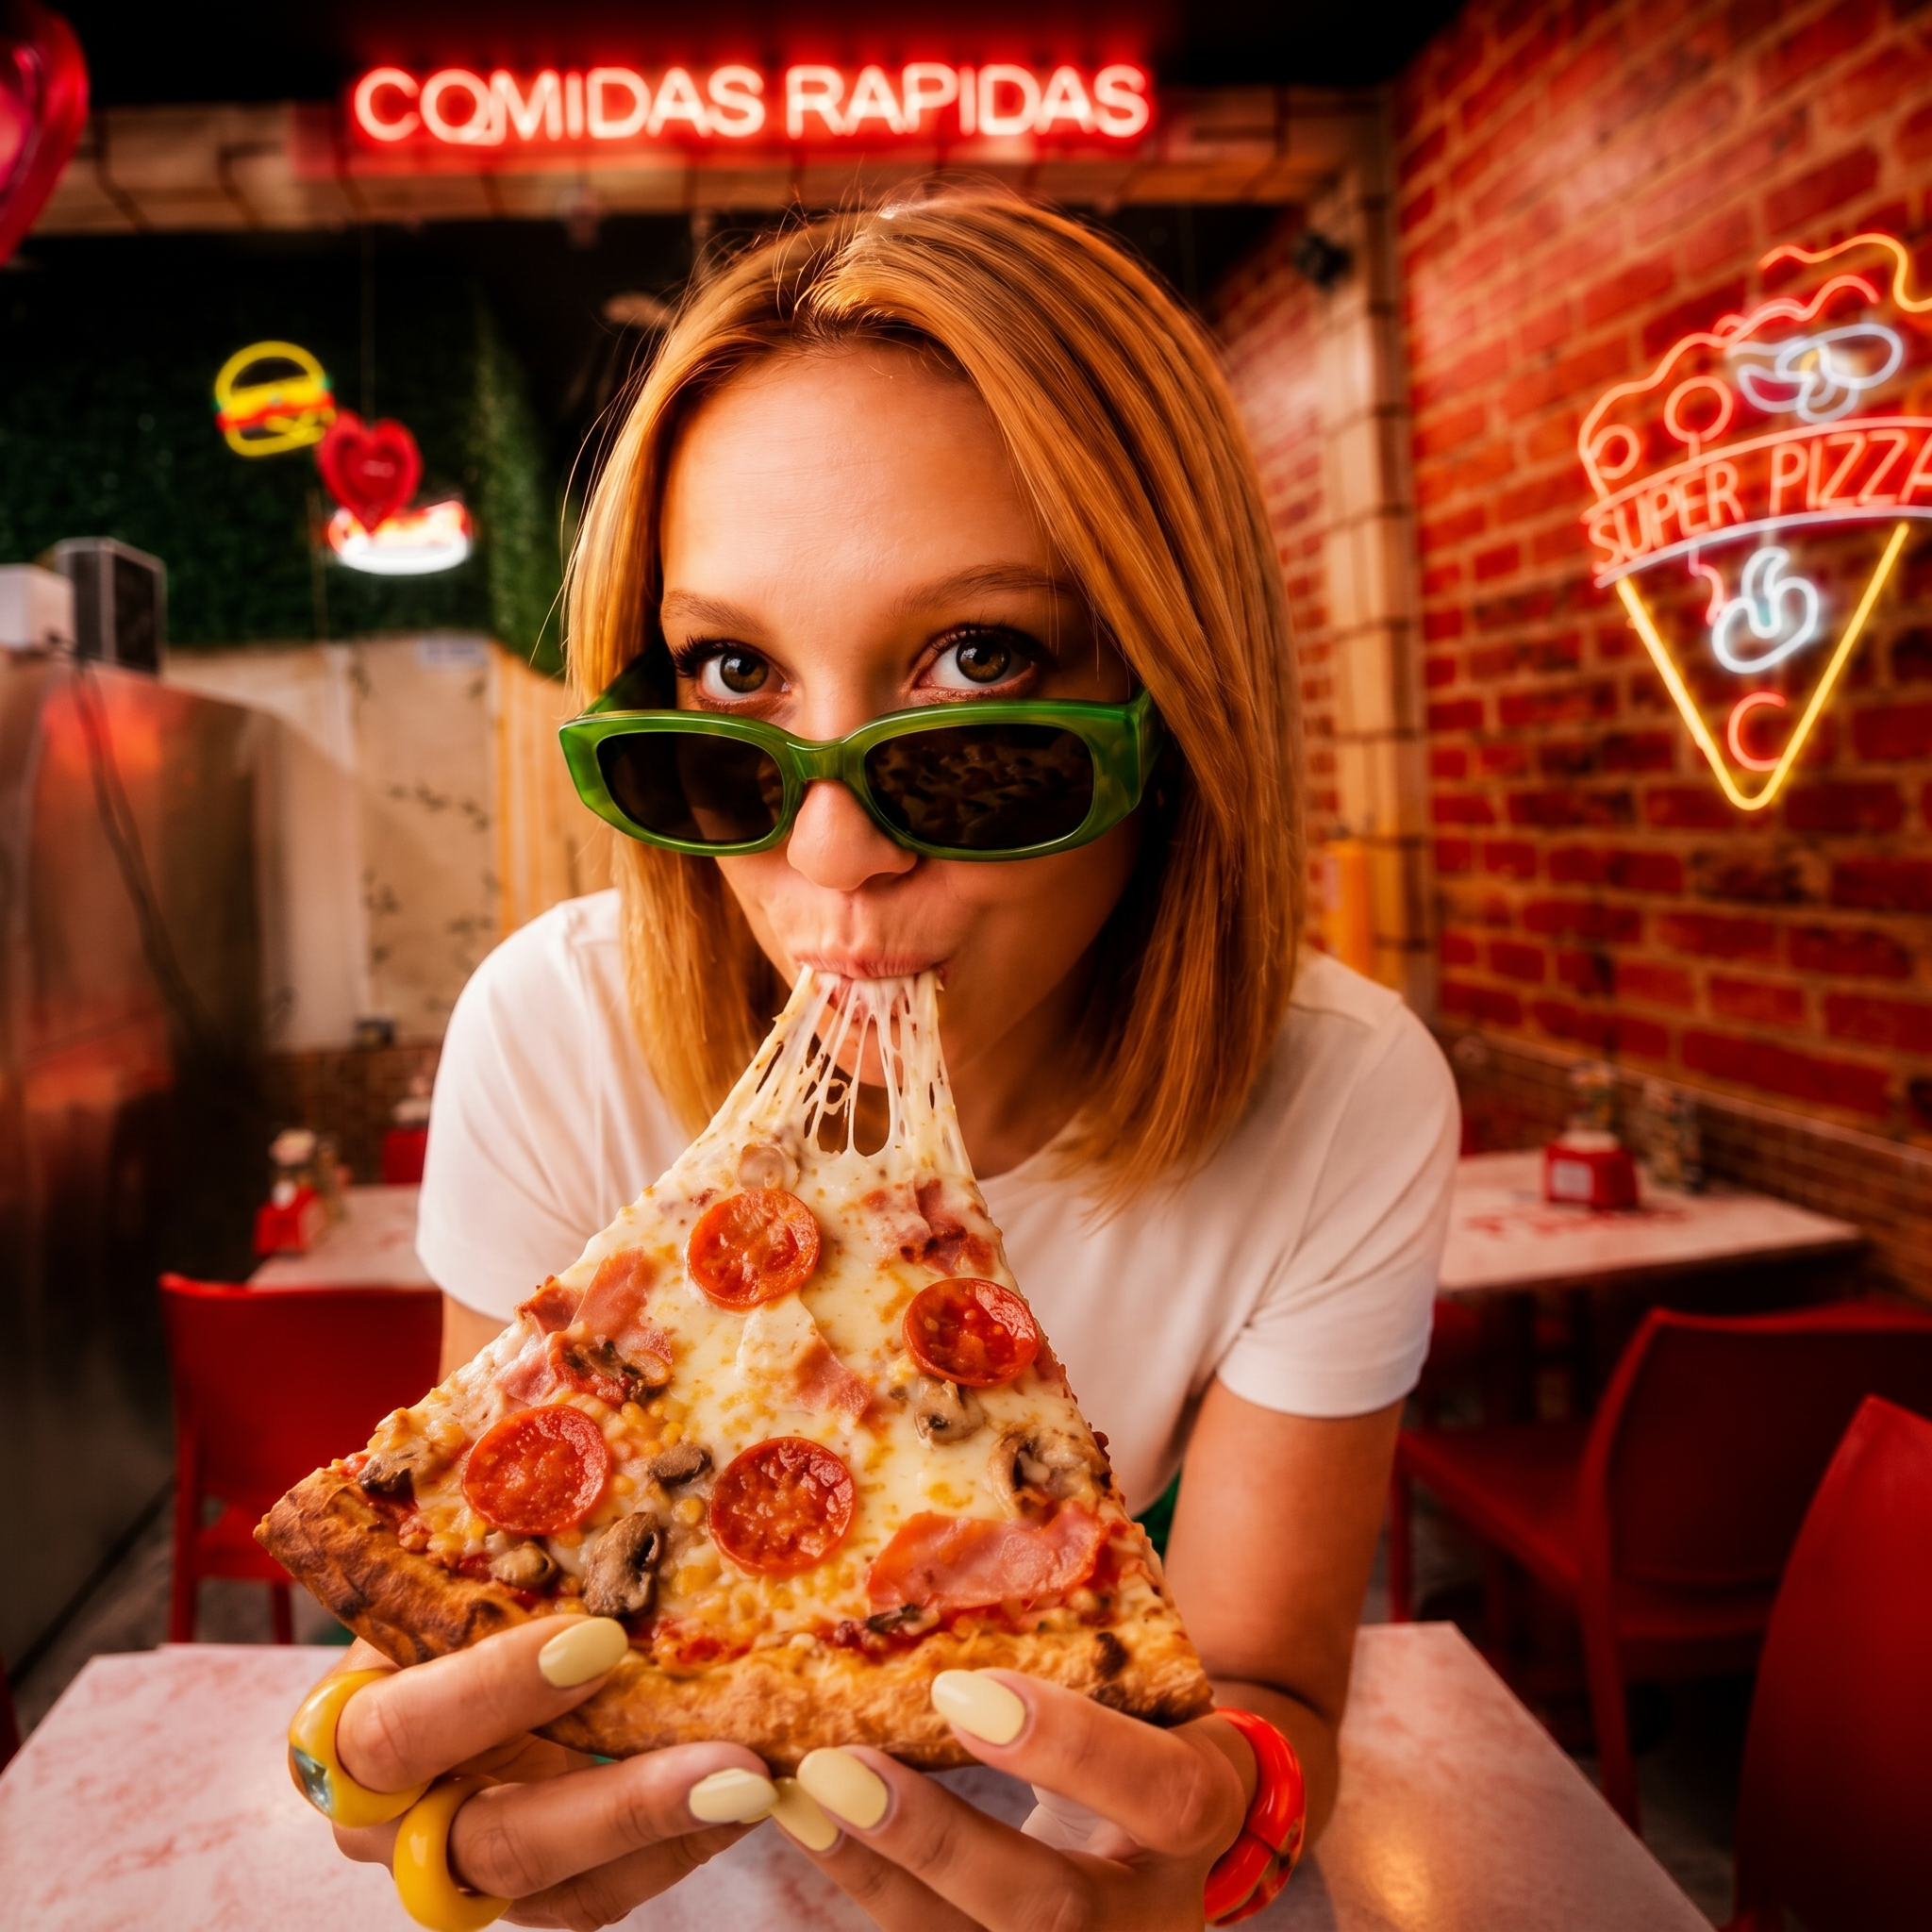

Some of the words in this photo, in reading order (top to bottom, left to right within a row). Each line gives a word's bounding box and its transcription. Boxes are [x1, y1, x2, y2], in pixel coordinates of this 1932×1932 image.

[355, 66, 766, 146] COMIDAS
[785, 61, 1149, 140] RAPIDAS
[1588, 460, 1745, 575] SUPER
